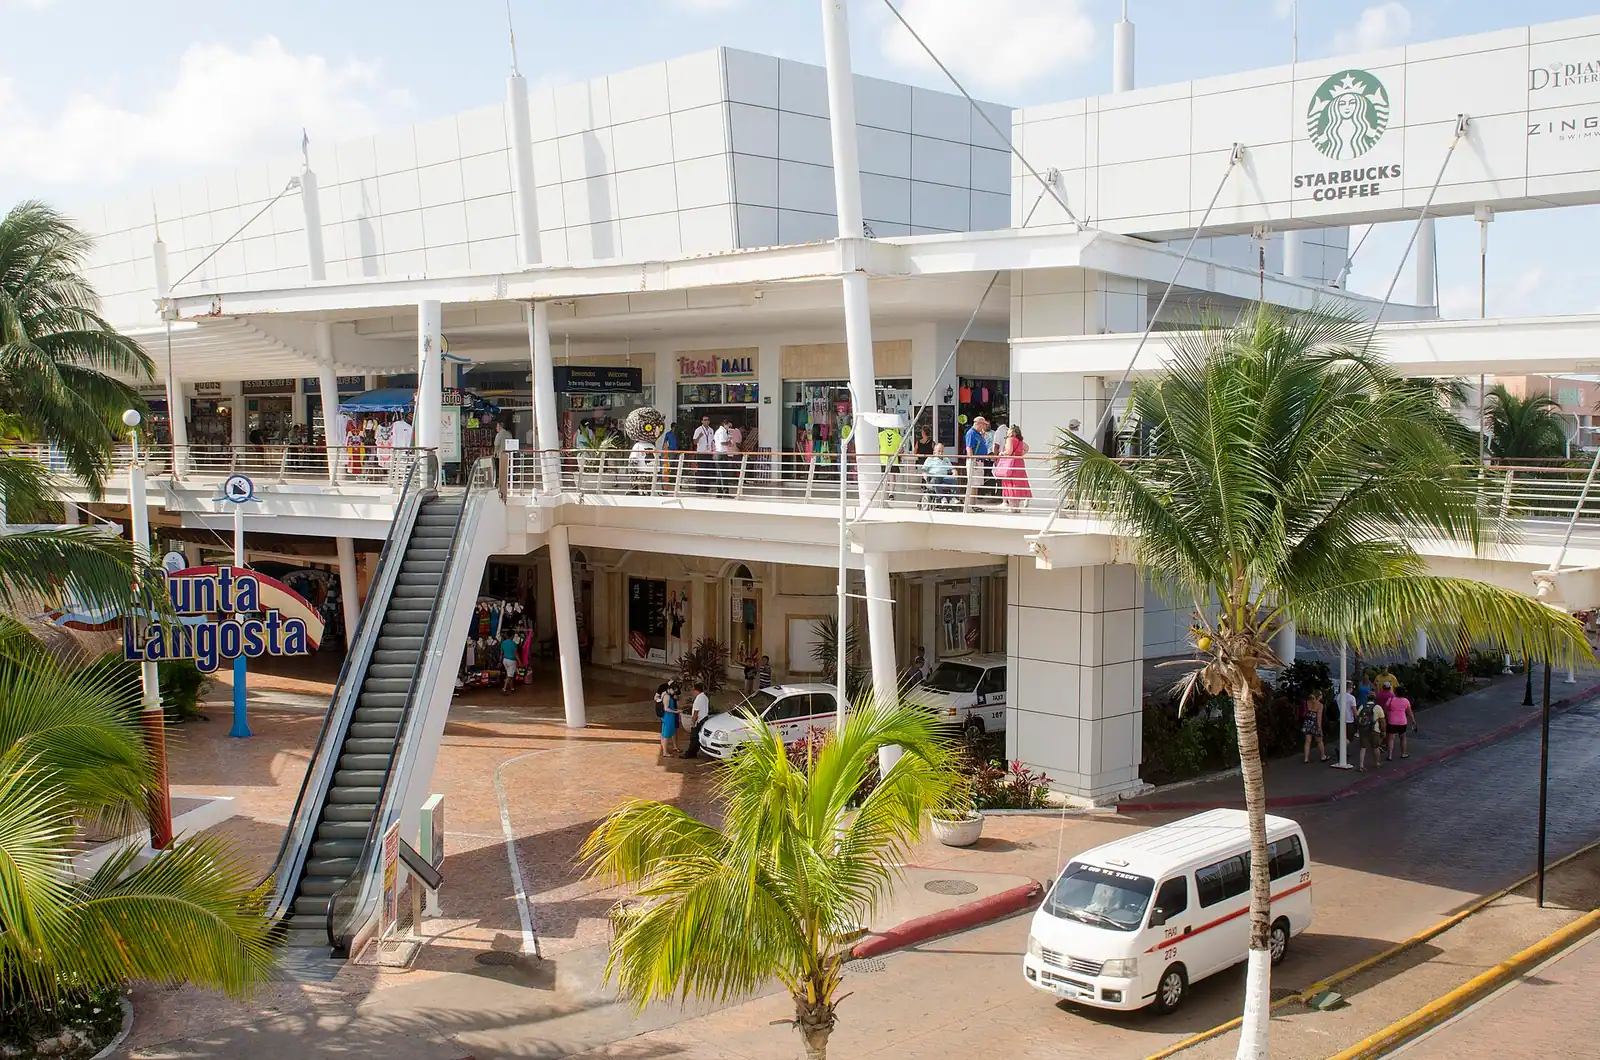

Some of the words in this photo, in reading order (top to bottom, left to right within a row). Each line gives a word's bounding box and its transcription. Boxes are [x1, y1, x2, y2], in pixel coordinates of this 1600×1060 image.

[1565, 73, 1600, 87] INTER
[1528, 117, 1599, 136] ZING
[1294, 164, 1401, 188] STARBUCKS
[1313, 183, 1381, 202] COFFEE
[721, 357, 755, 373] MALL
[124, 610, 309, 674] Langosta
[1164, 926, 1178, 939] TAXI
[1164, 946, 1178, 961] 279
